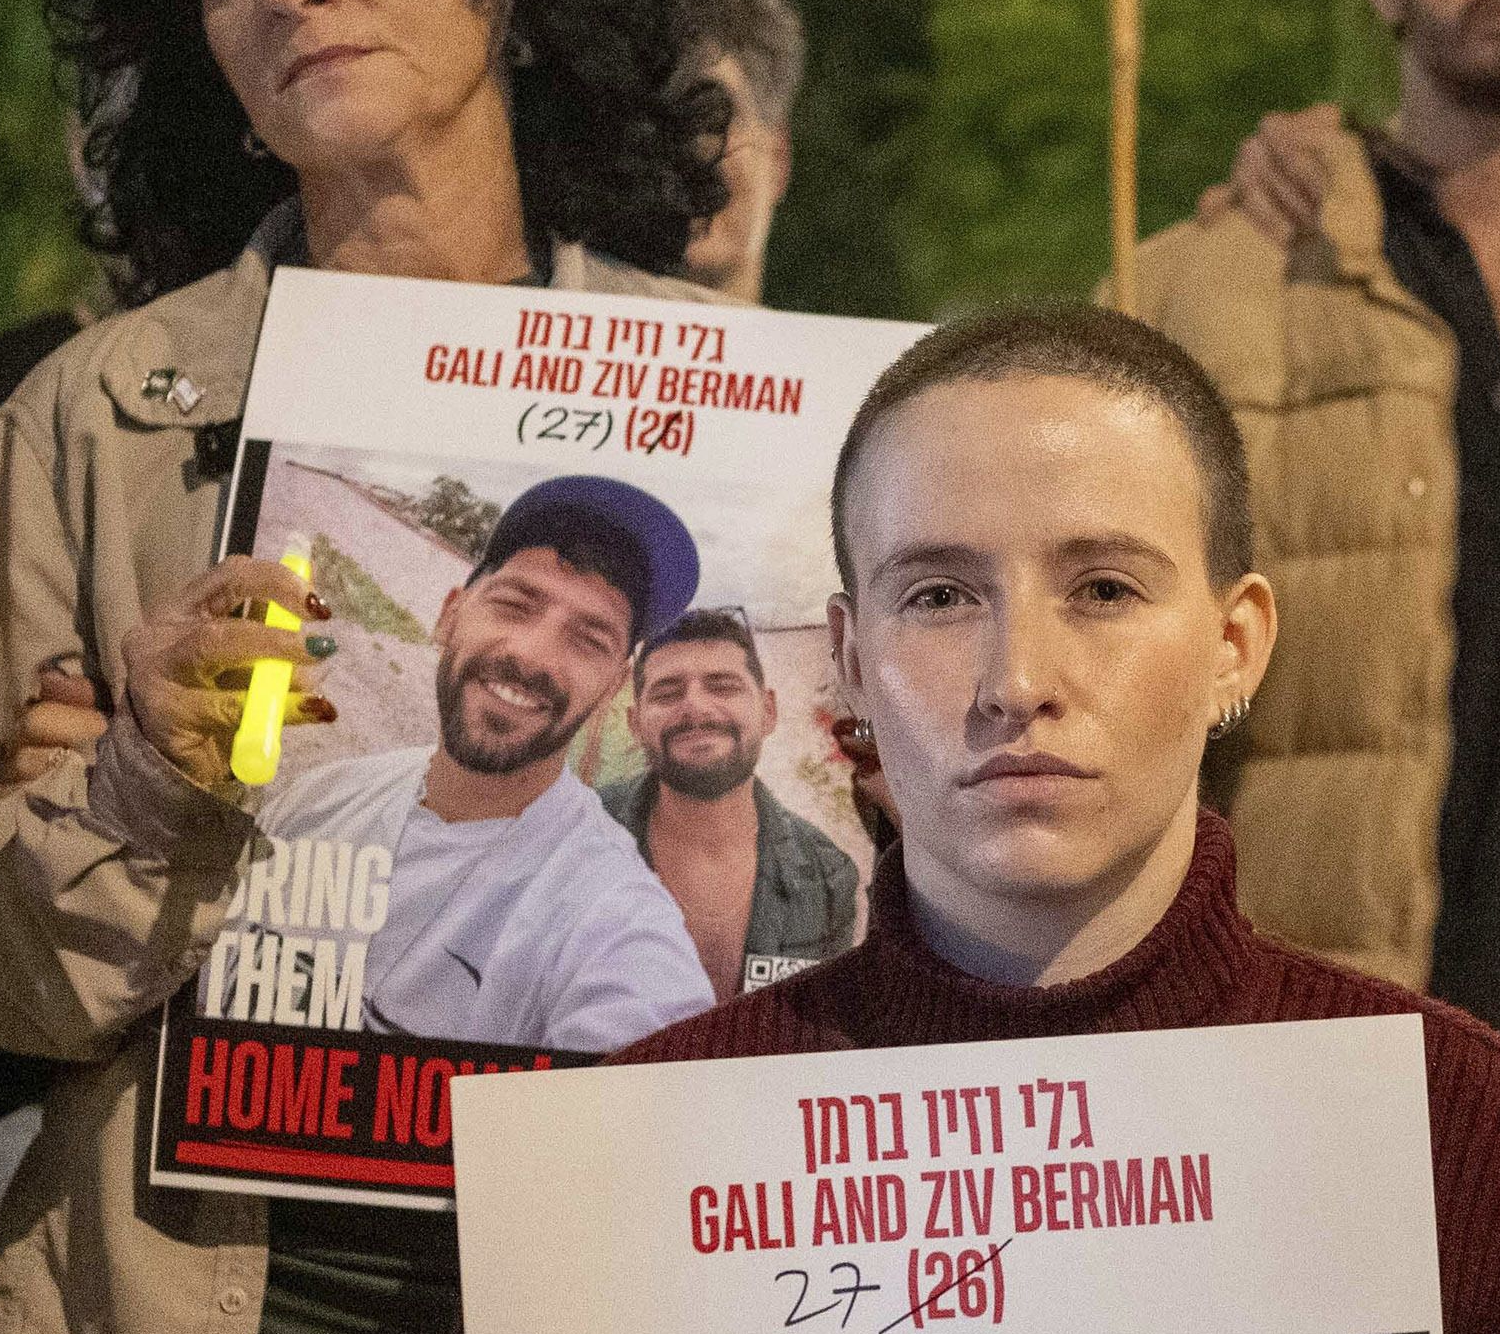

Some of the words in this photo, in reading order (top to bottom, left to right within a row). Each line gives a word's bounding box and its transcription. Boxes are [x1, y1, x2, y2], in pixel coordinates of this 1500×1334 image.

[517, 310, 593, 351] ברמן
[607, 318, 663, 357] וזיו
[678, 324, 725, 363] גלי
[425, 345, 503, 386] GALI
[511, 353, 583, 394] AND
[592, 360, 648, 400] ZIV
[657, 366, 802, 414] BERMAN
[517, 403, 614, 451] (27)
[625, 406, 694, 456] (26)
[205, 930, 367, 1032] THEM
[187, 1037, 359, 1138] HOME
[922, 1087, 1003, 1157] וזיו
[1019, 1078, 1093, 1150] גלי
[798, 1093, 908, 1174] ברמן
[690, 1181, 795, 1254] GALI
[813, 1175, 907, 1246] AND
[921, 1168, 994, 1238] ZIV
[1012, 1154, 1212, 1233] BERMAN
[775, 1262, 881, 1328] 27
[907, 1243, 1005, 1328] (26)
